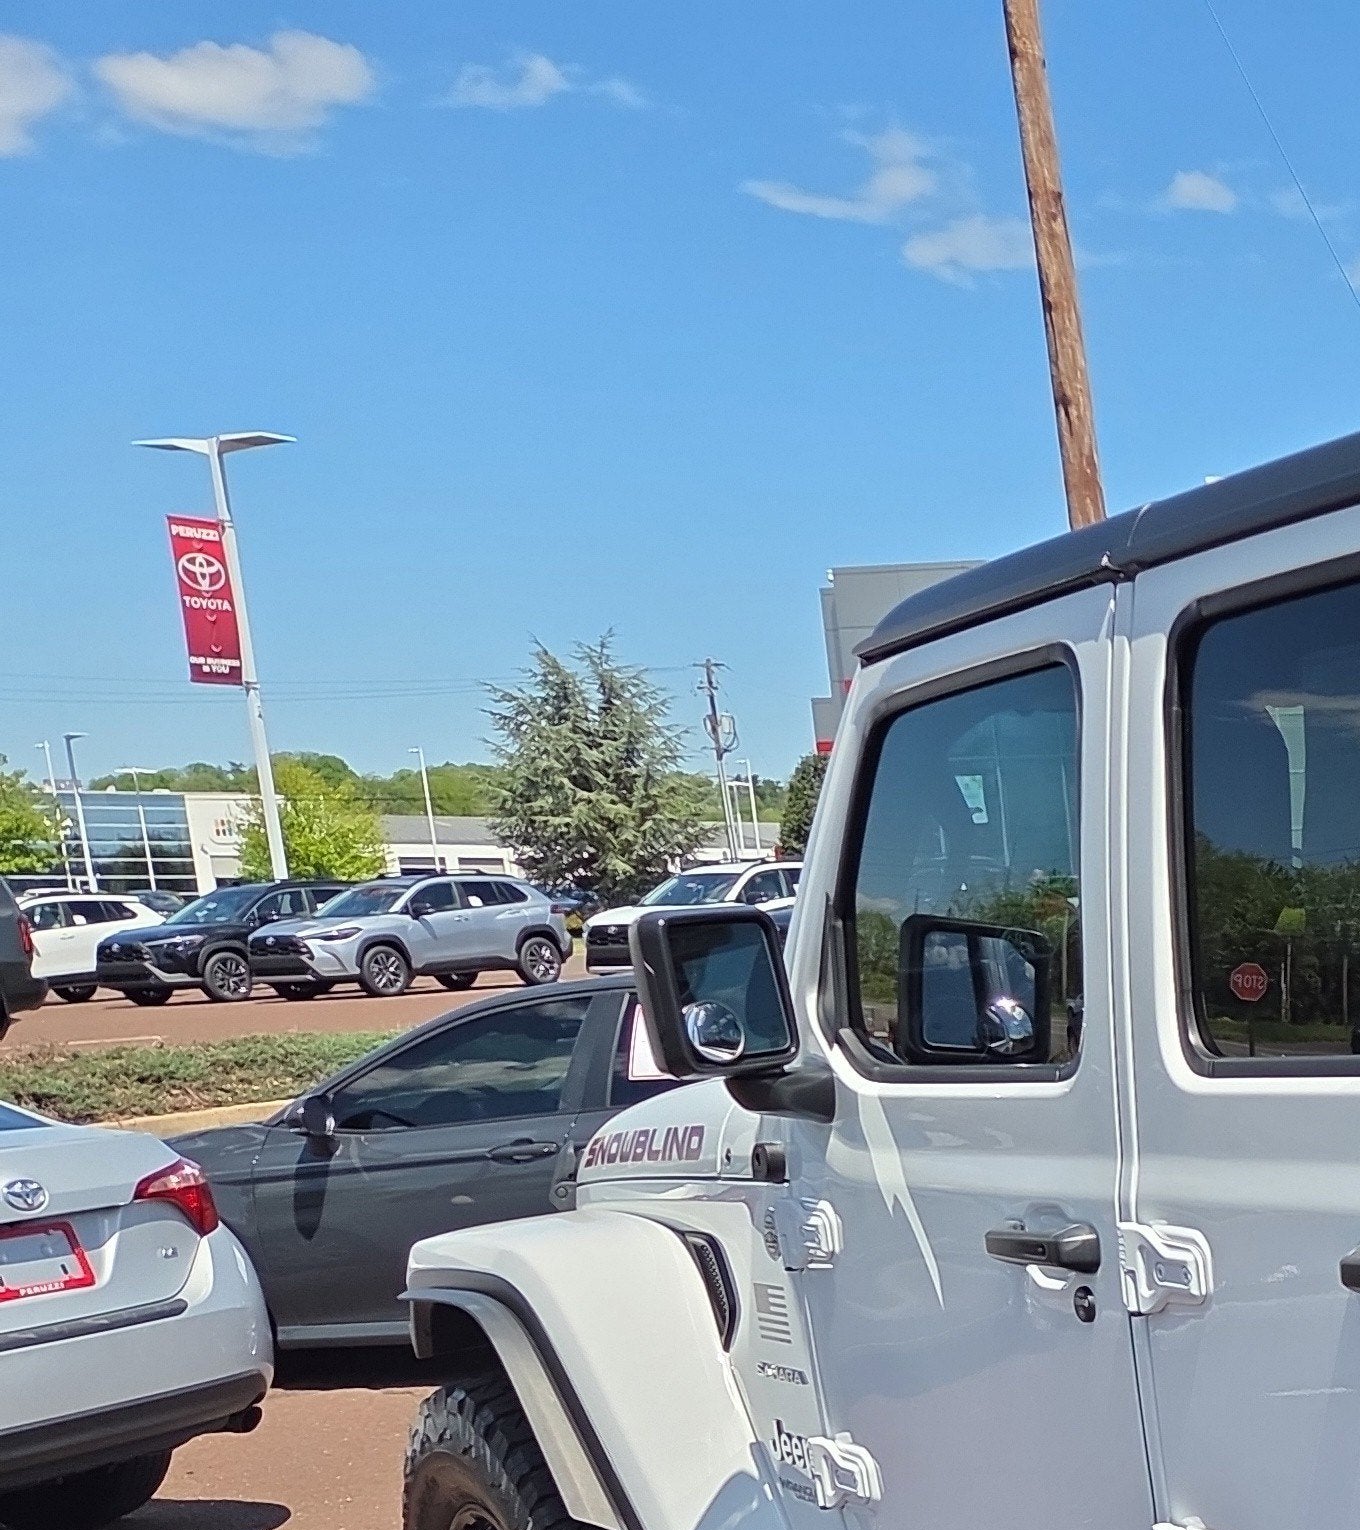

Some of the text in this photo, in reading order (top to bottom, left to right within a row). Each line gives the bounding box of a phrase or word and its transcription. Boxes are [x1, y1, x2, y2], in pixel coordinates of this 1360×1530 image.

[170, 524, 220, 542] PERUZZI
[182, 596, 232, 612] TOYOTA
[211, 664, 230, 675] YOU
[584, 1124, 705, 1169] SNOWBLIND
[18, 1281, 66, 1297] PERUZZI
